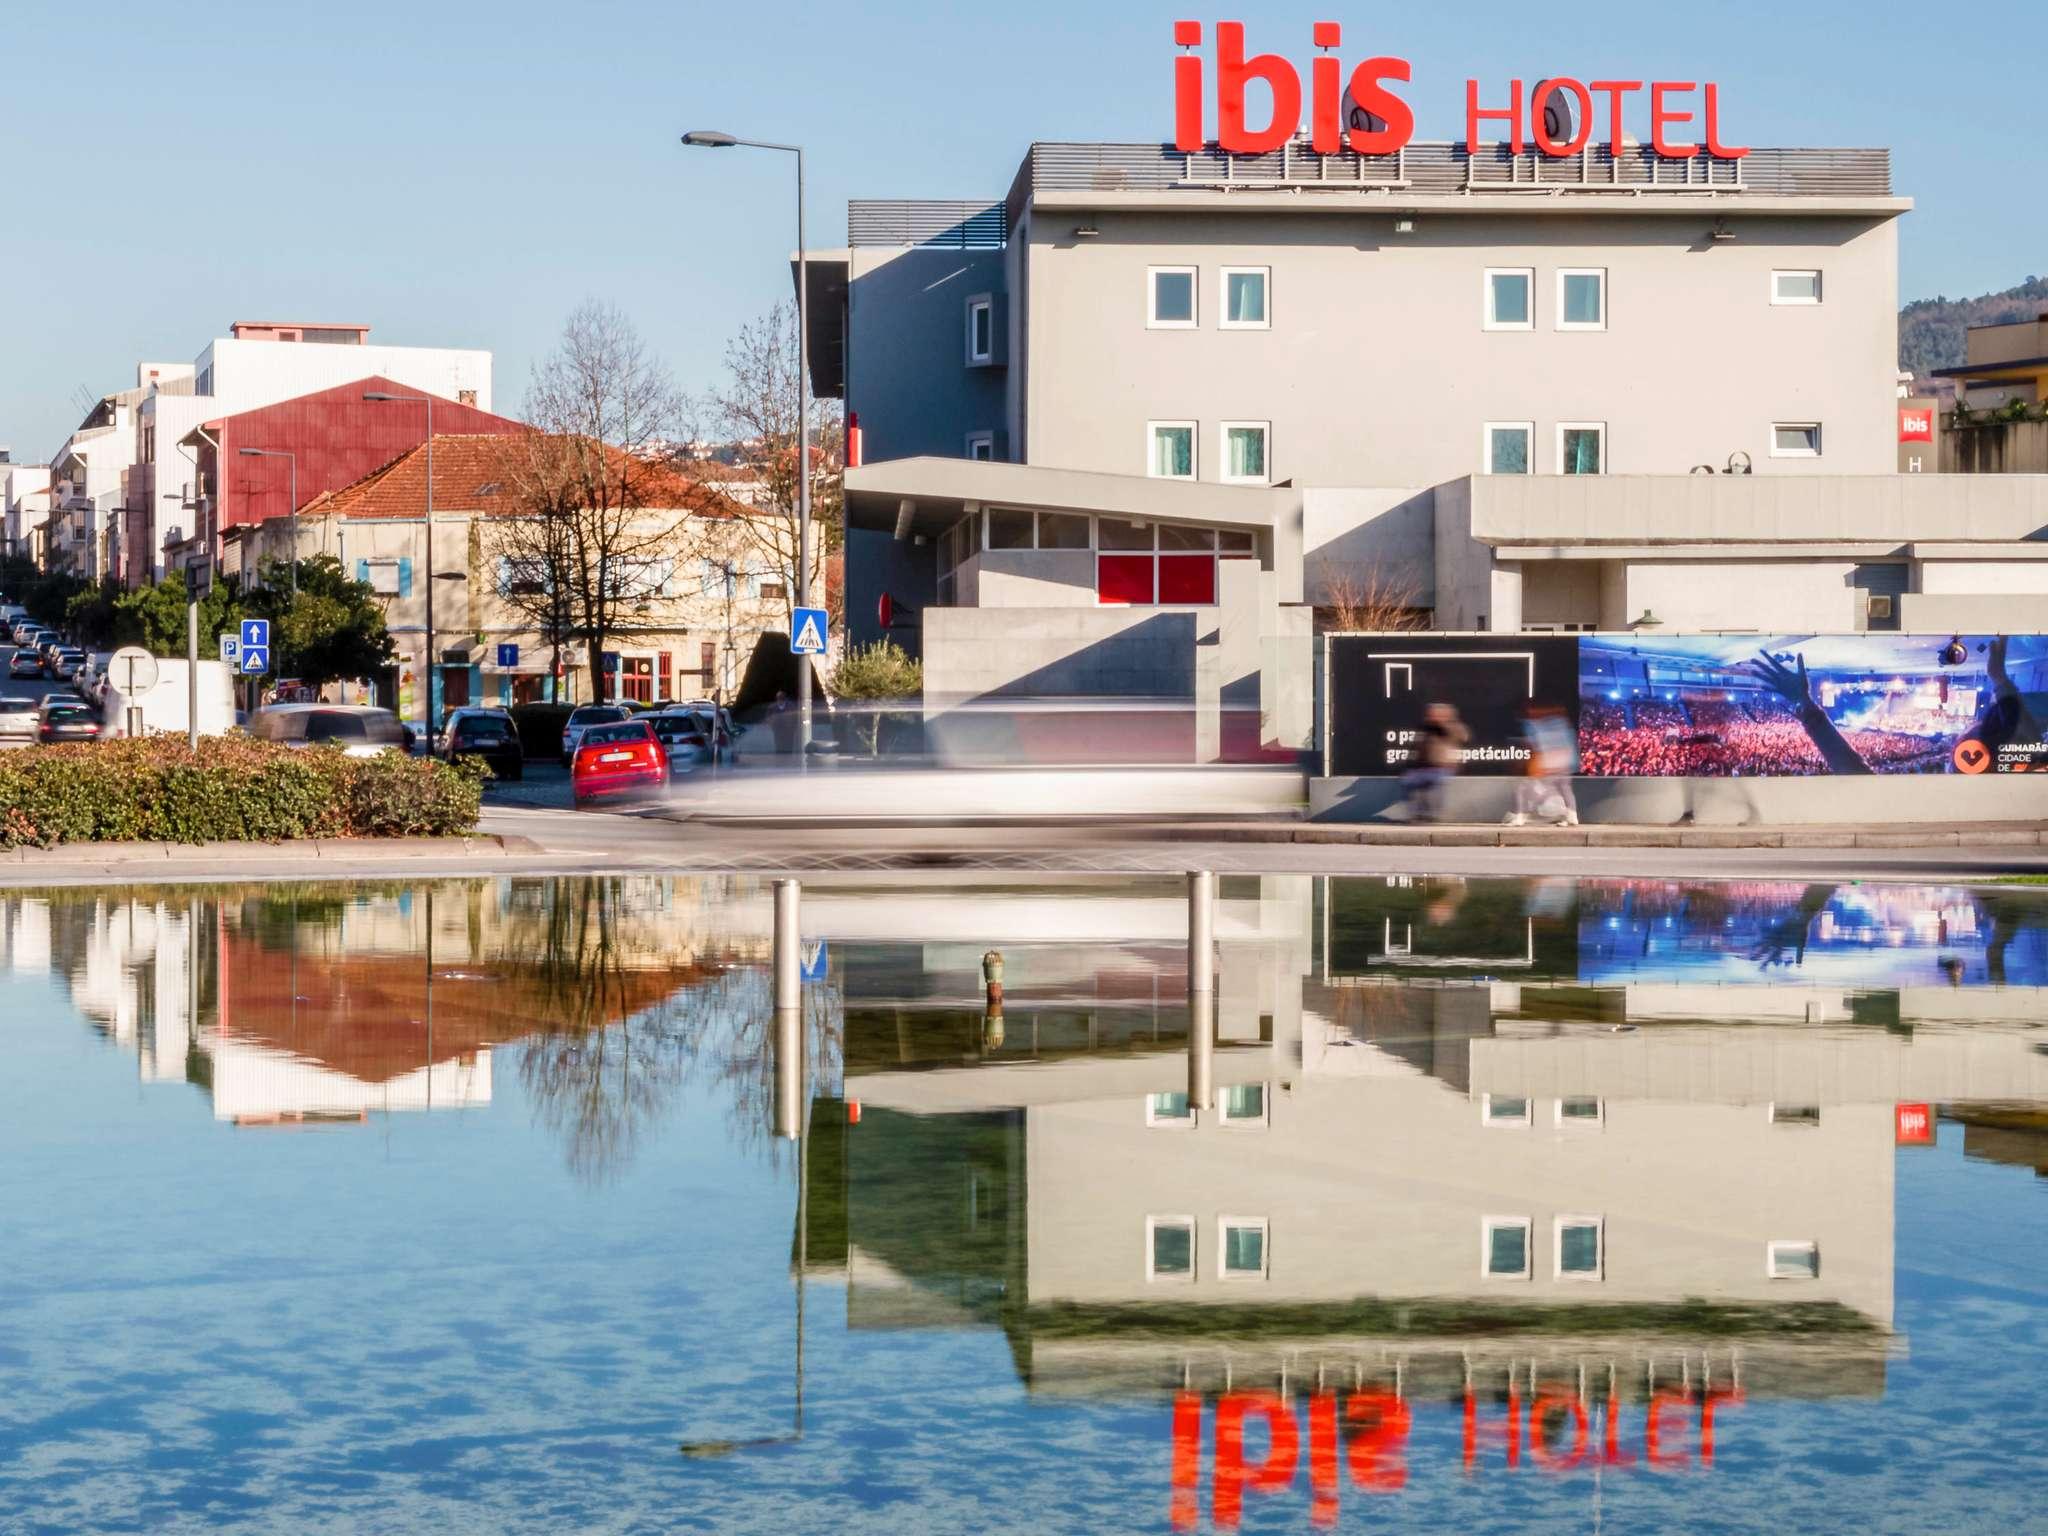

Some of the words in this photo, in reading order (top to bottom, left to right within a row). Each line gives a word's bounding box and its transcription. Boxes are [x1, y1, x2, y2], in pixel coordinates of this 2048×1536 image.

[1175, 21, 1414, 155] ibis
[1466, 77, 1750, 159] HOTEL
[1903, 416, 1929, 433] ibis
[1998, 742, 2048, 752] GUIMARÃE
[1998, 753, 2032, 762] CIDADE
[1998, 763, 2010, 772] DE
